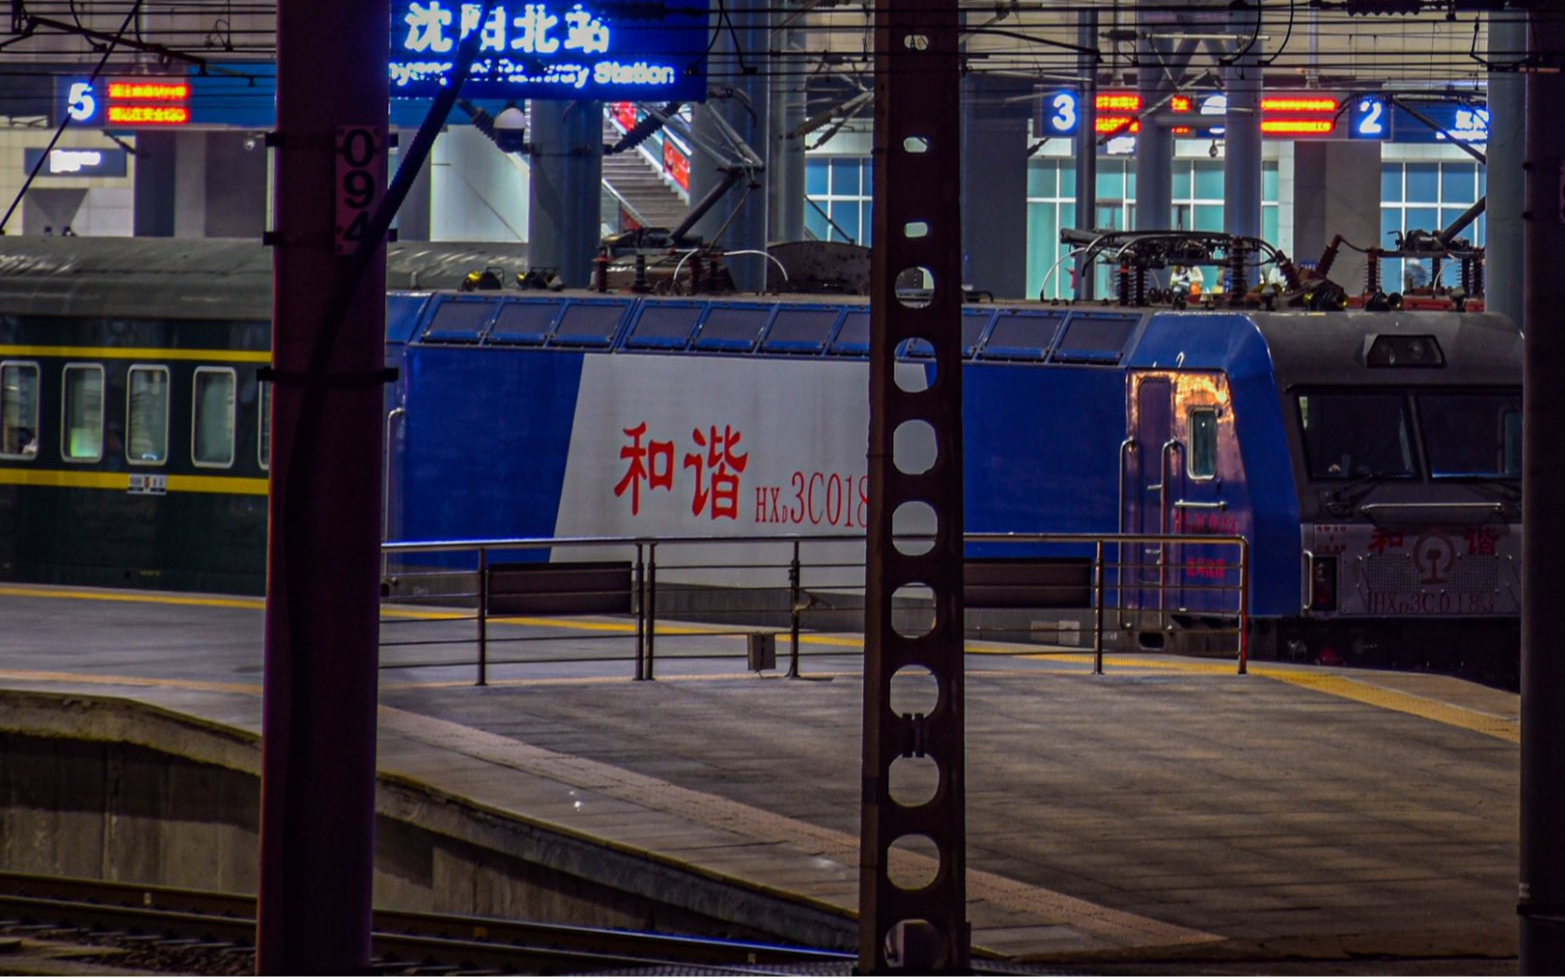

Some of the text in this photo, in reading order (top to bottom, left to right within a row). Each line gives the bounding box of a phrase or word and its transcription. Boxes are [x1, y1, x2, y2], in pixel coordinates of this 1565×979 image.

[404, 1, 611, 53] 沈阳北站
[594, 60, 676, 85] Station
[68, 82, 95, 120] 5
[1051, 93, 1077, 130] 3
[1359, 98, 1383, 133] 2
[614, 422, 749, 520] 和谐
[755, 471, 869, 528] HXD3C018
[1368, 525, 1502, 555] 和 谐
